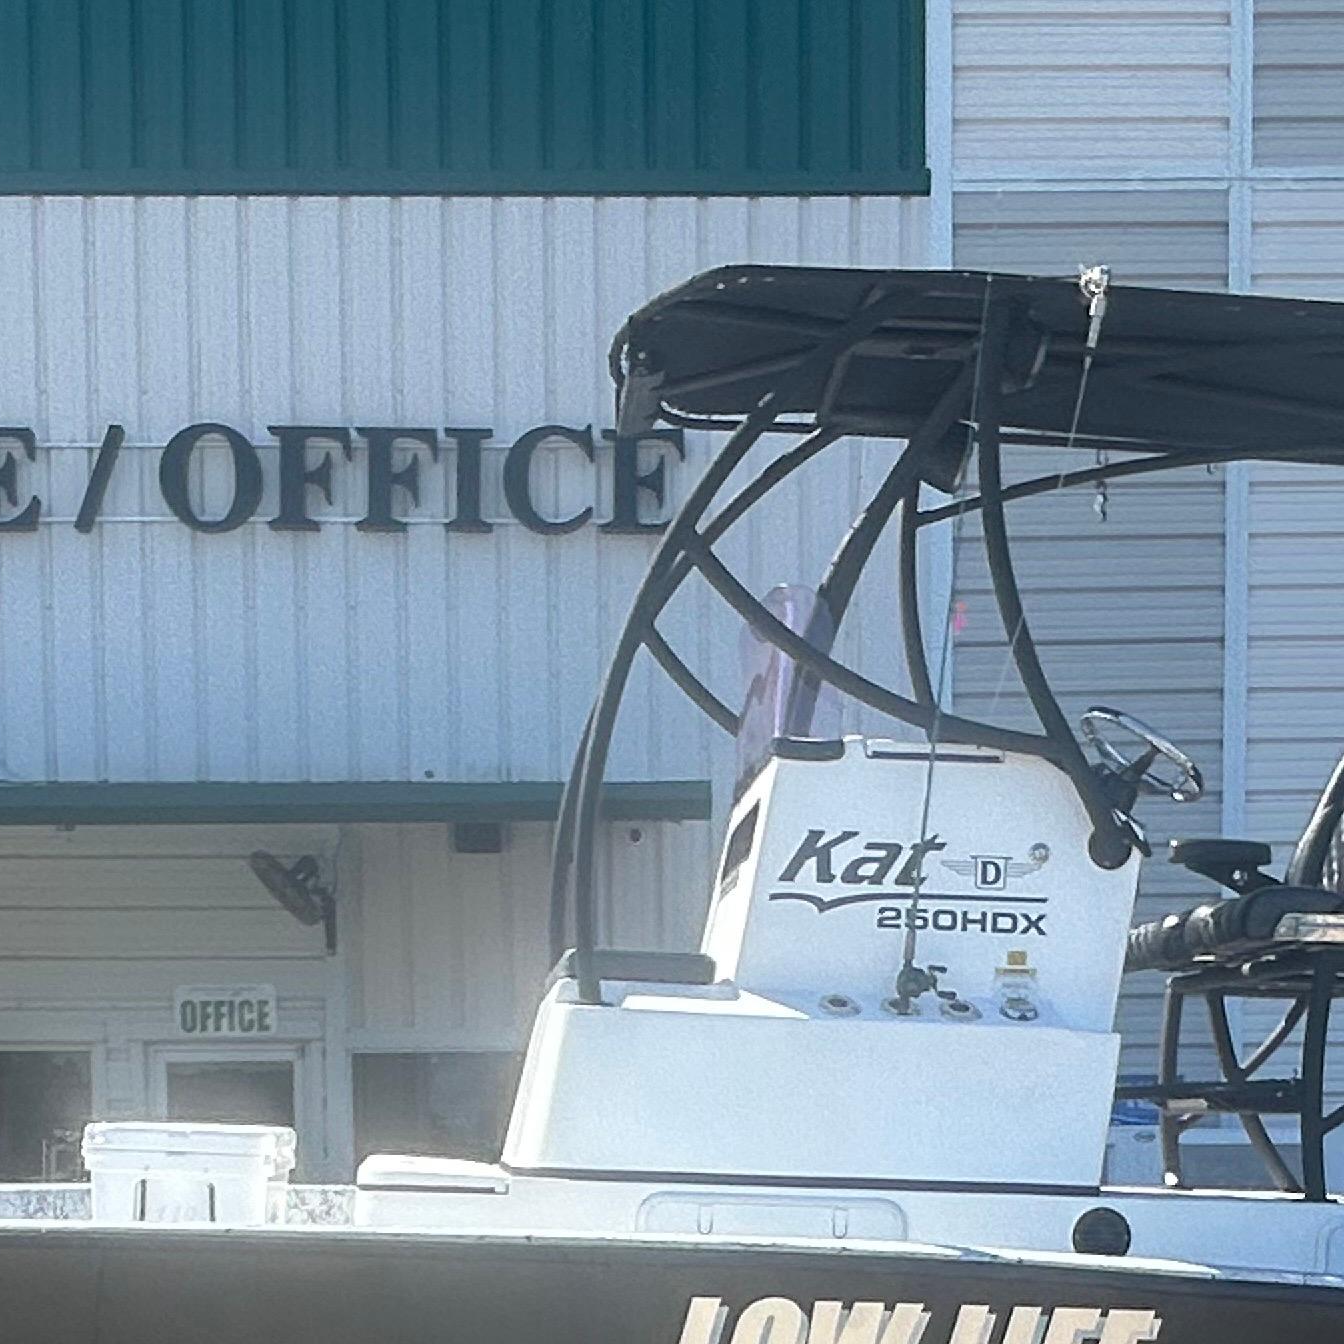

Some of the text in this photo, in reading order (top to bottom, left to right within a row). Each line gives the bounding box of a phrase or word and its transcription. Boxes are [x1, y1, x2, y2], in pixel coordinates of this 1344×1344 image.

[73, 423, 126, 534] /
[158, 423, 688, 535] OFFICE
[778, 829, 948, 886] Kat
[980, 860, 1002, 886] D
[876, 906, 1048, 936] 250HDX
[179, 999, 272, 1034] OFFICE
